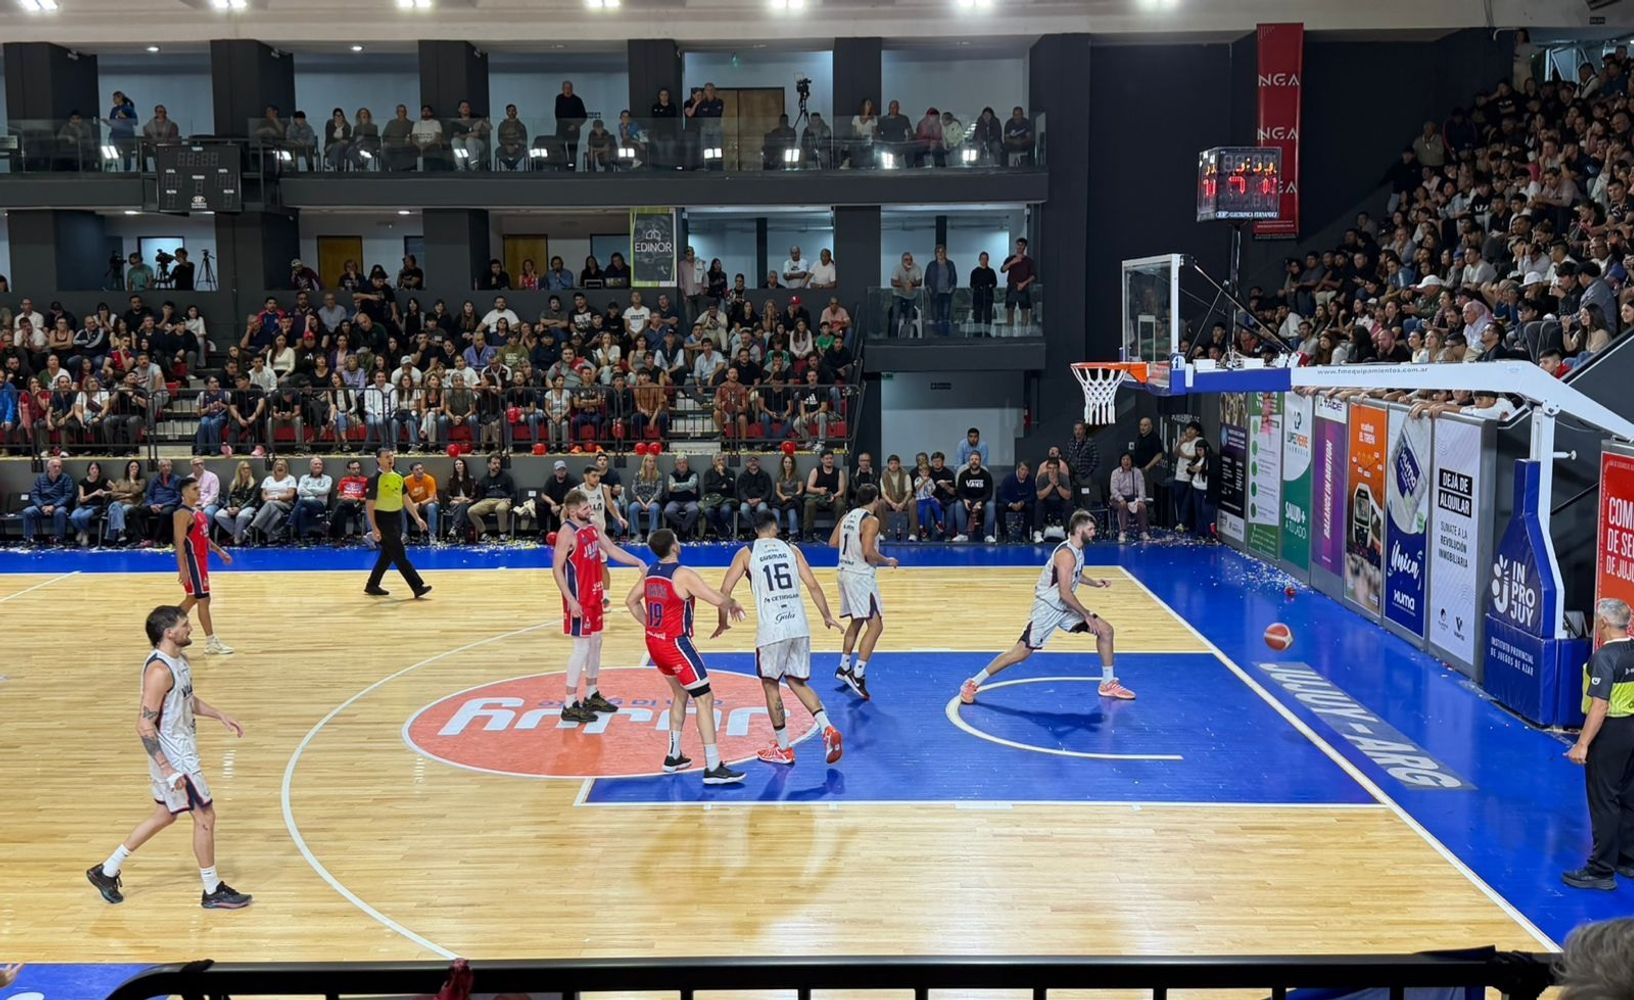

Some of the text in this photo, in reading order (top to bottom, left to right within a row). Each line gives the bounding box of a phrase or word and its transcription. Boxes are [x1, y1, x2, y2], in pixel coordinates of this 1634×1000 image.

[1258, 73, 1299, 87] NGA
[1257, 127, 1298, 140] NGA
[635, 242, 672, 253] EDINOR
[965, 479, 984, 488] VANS
[1442, 472, 1469, 493] DEJÁ DE
[1440, 493, 1470, 515] ALQUILAR
[1609, 496, 1634, 530] COM
[842, 533, 848, 555] 1
[1607, 527, 1634, 560] DE SE
[763, 562, 793, 591] 16
[1513, 561, 1525, 584] IN
[1606, 555, 1616, 576] DE
[1512, 581, 1535, 608] PRO
[1510, 600, 1534, 627] JUY
[1490, 647, 1496, 658] DE
[1497, 651, 1514, 666] JUEGOS
[1521, 662, 1533, 676] AZAR
